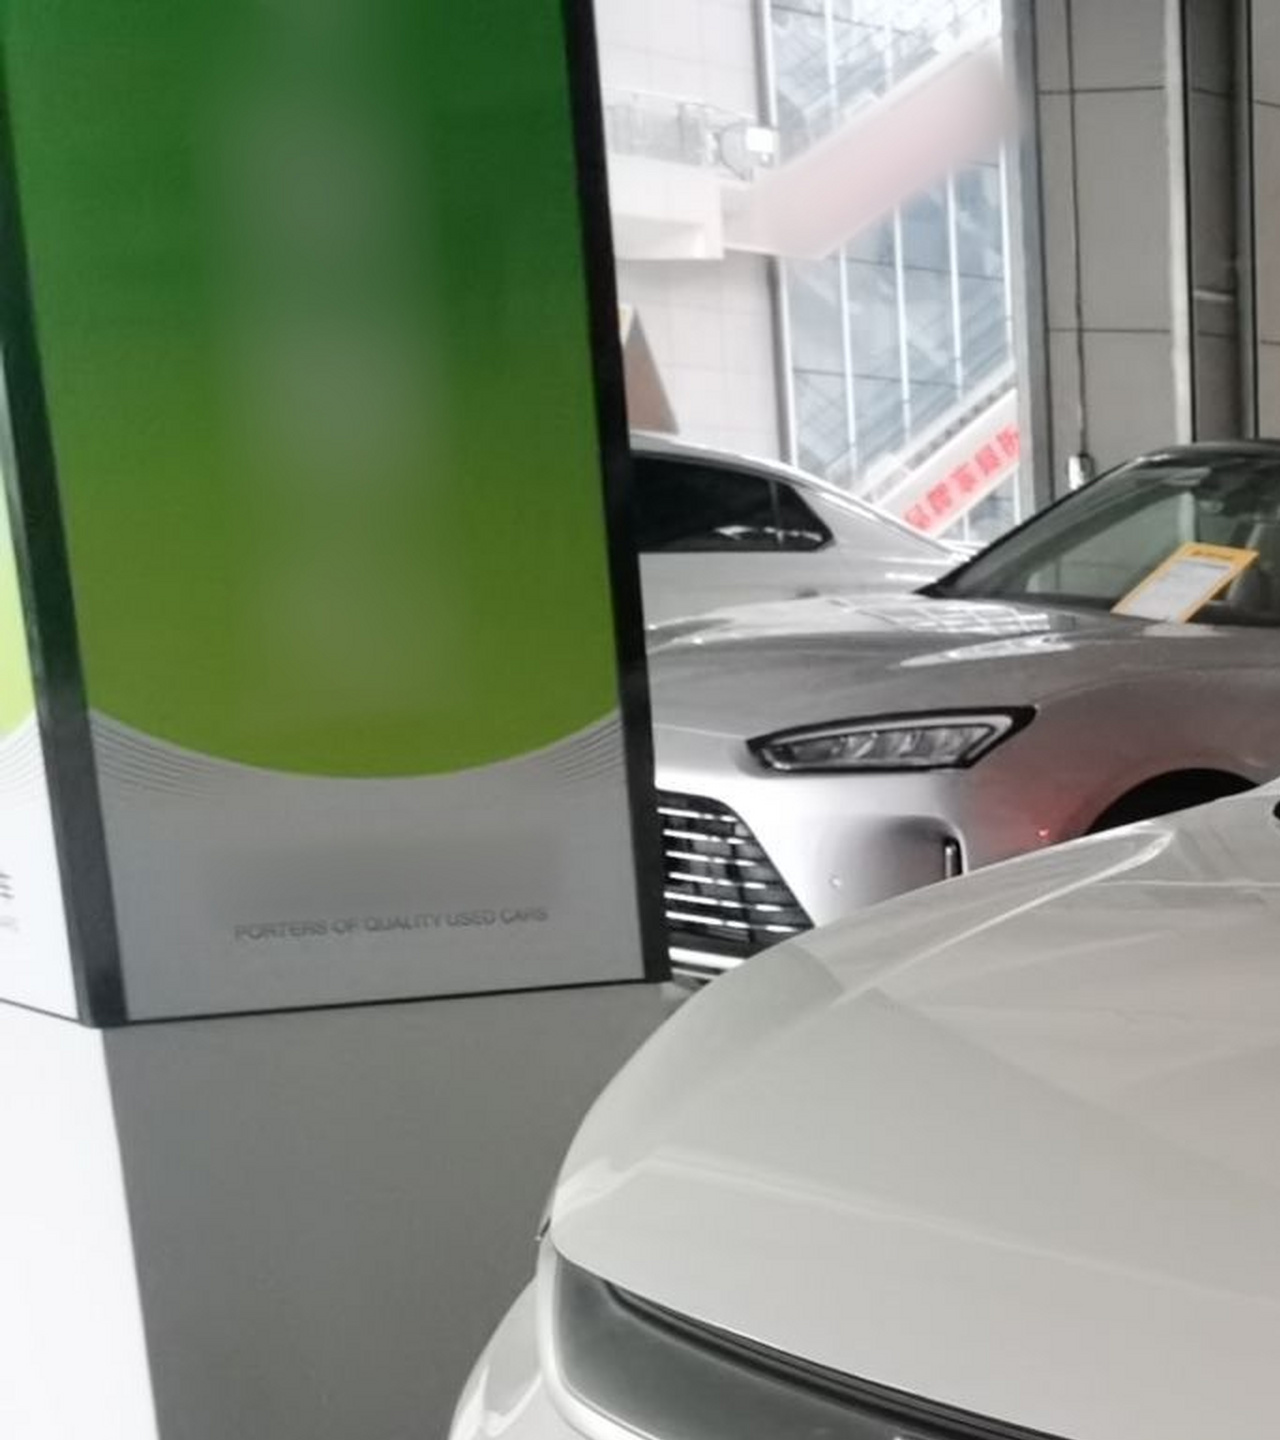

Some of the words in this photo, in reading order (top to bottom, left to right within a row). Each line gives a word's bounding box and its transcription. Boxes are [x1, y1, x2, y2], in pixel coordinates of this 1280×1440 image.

[330, 918, 359, 934] OF
[364, 914, 442, 932] QUALITY
[445, 909, 497, 928] USED
[500, 907, 550, 925] CARS
